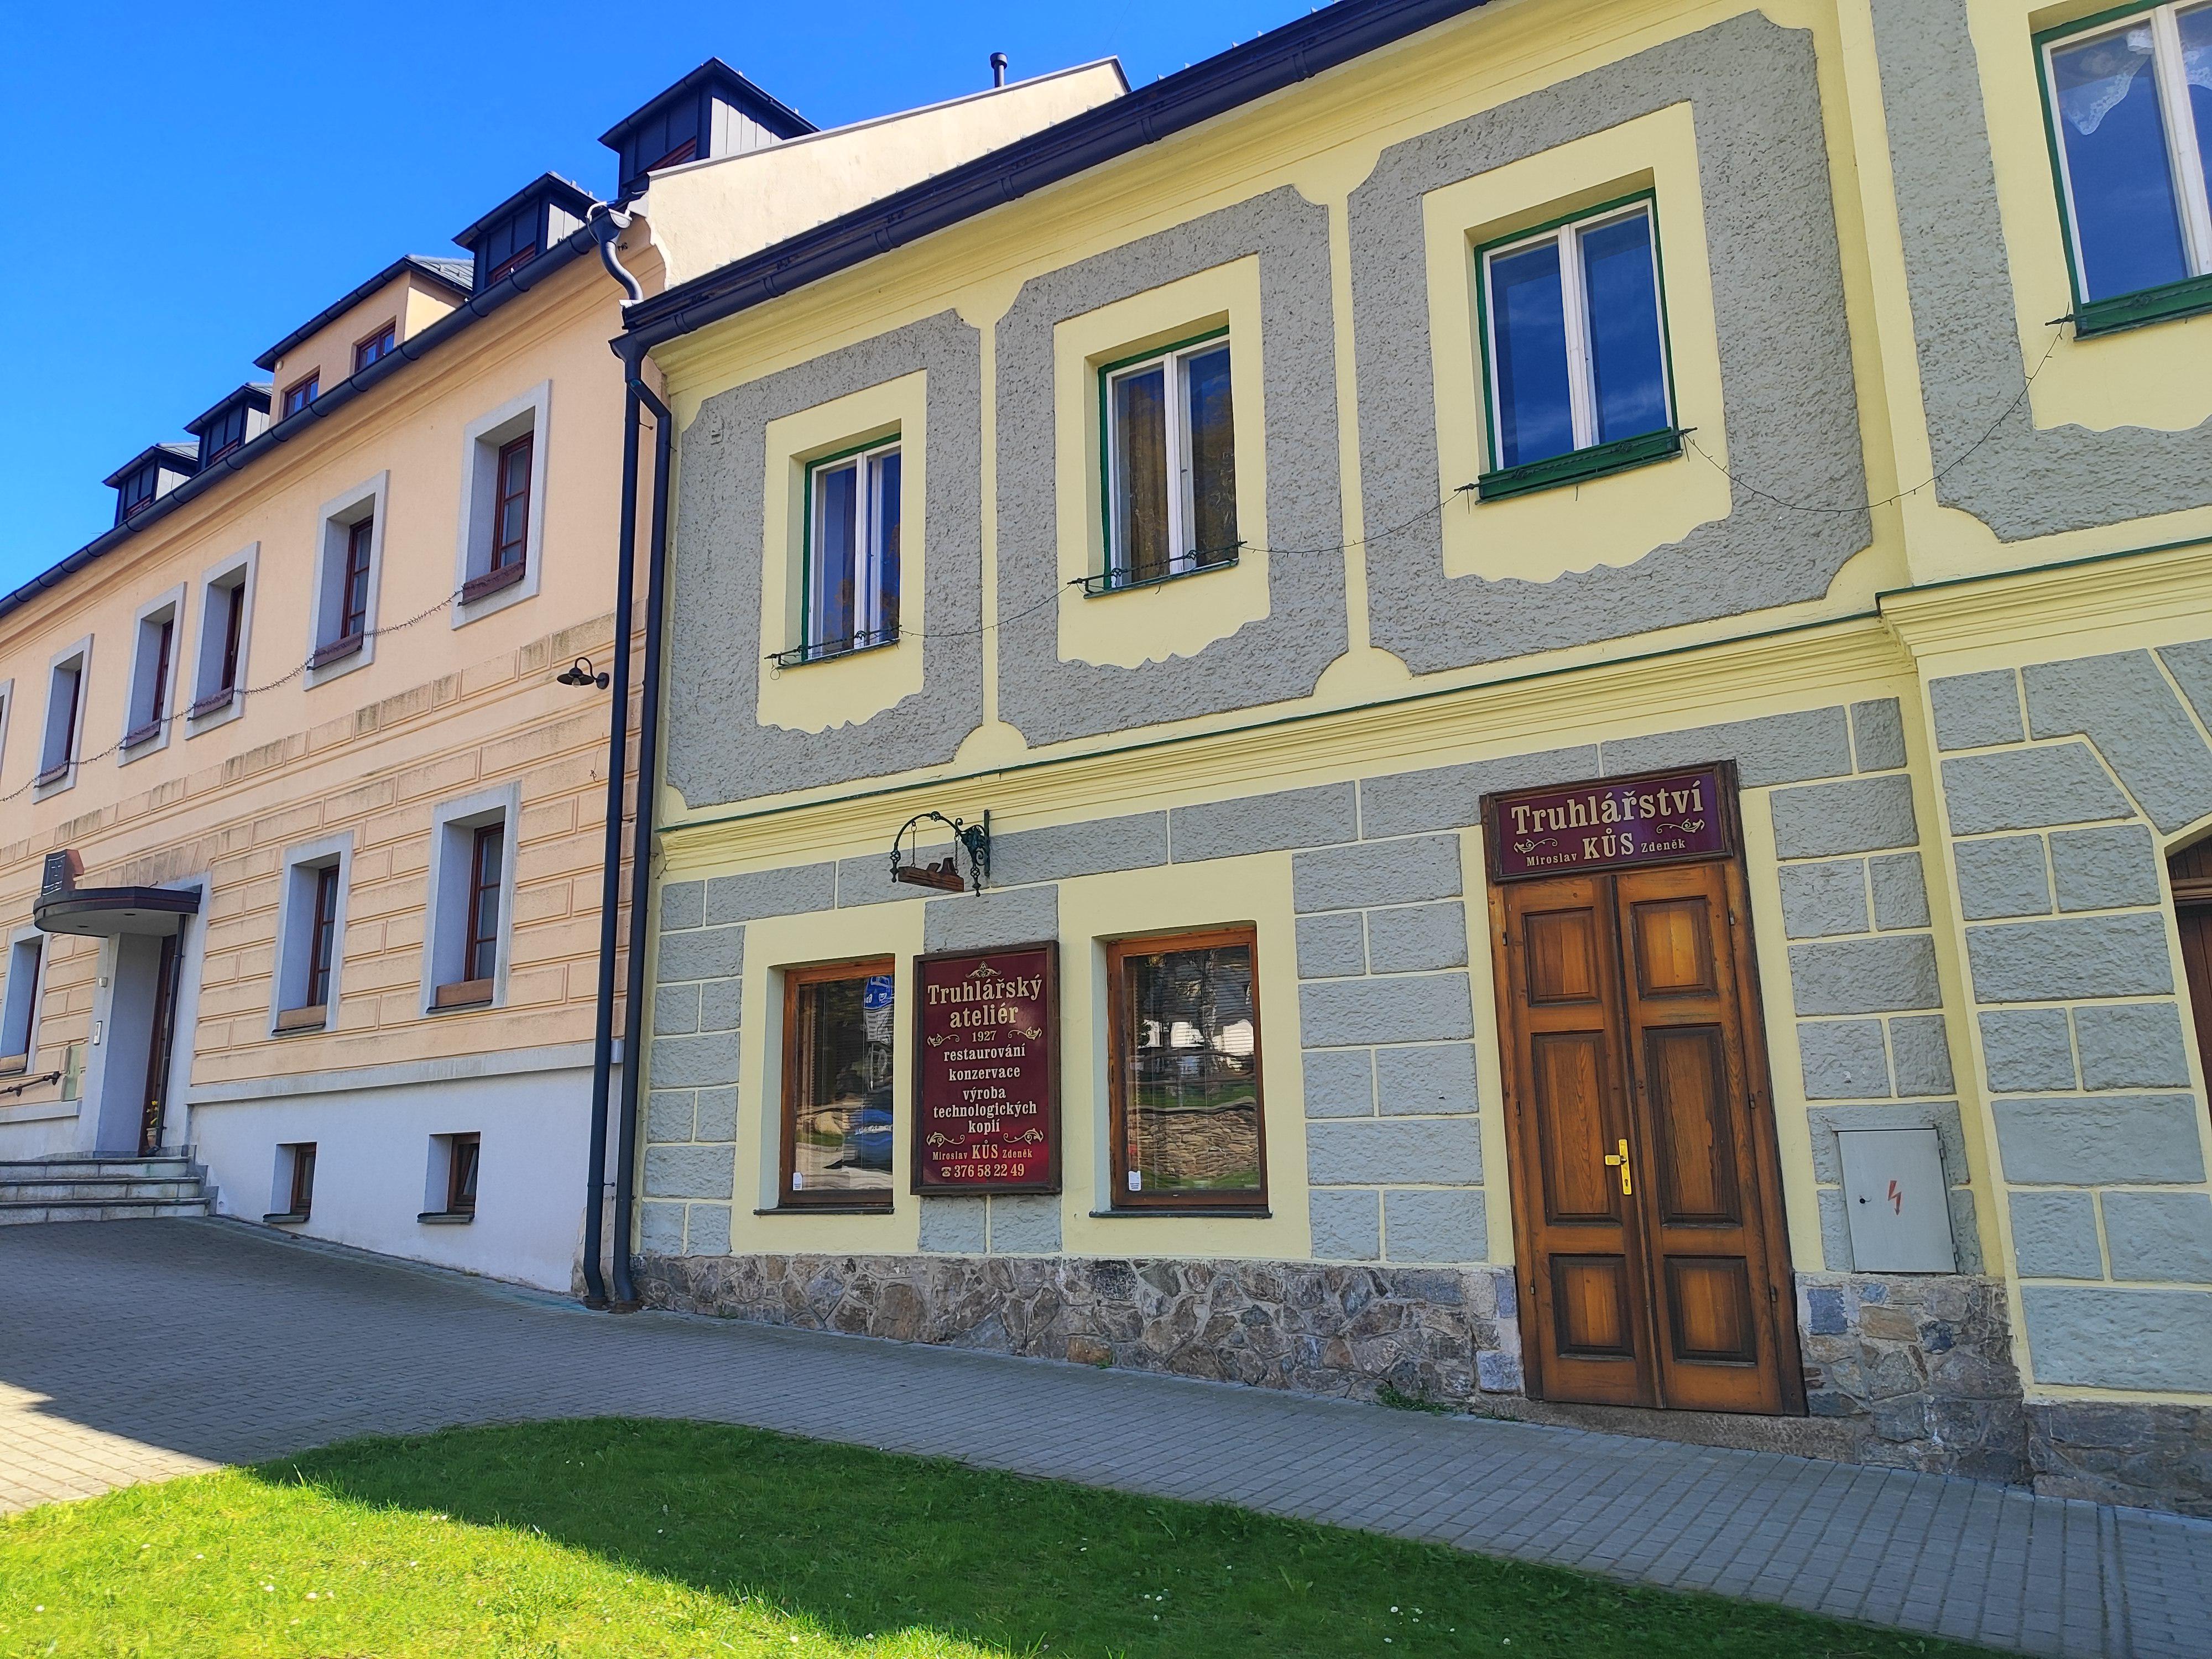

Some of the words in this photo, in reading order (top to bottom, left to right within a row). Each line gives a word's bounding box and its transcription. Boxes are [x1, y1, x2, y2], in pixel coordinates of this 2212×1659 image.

[1511, 780, 1704, 836] Truhlářství
[1526, 852, 1578, 867] Miroslav
[1582, 827, 1635, 860] KŮS
[1640, 838, 1686, 853] Zdeněk
[927, 974, 1042, 1005] Truhlářský
[950, 1002, 1019, 1028] ateliér
[972, 1030, 997, 1042] 1927
[943, 1042, 1026, 1062] restaurování
[948, 1066, 1021, 1081] konzervace
[963, 1086, 1006, 1103] výroba
[933, 1100, 1037, 1119] technologických
[968, 1118, 1000, 1135] kopií
[972, 1139, 999, 1159] KŮS
[1002, 1149, 1032, 1159] Zdeněk
[954, 1165, 974, 1178] 376
[977, 1164, 991, 1177] 58
[994, 1164, 1008, 1177] 22
[1010, 1163, 1025, 1176] 49
